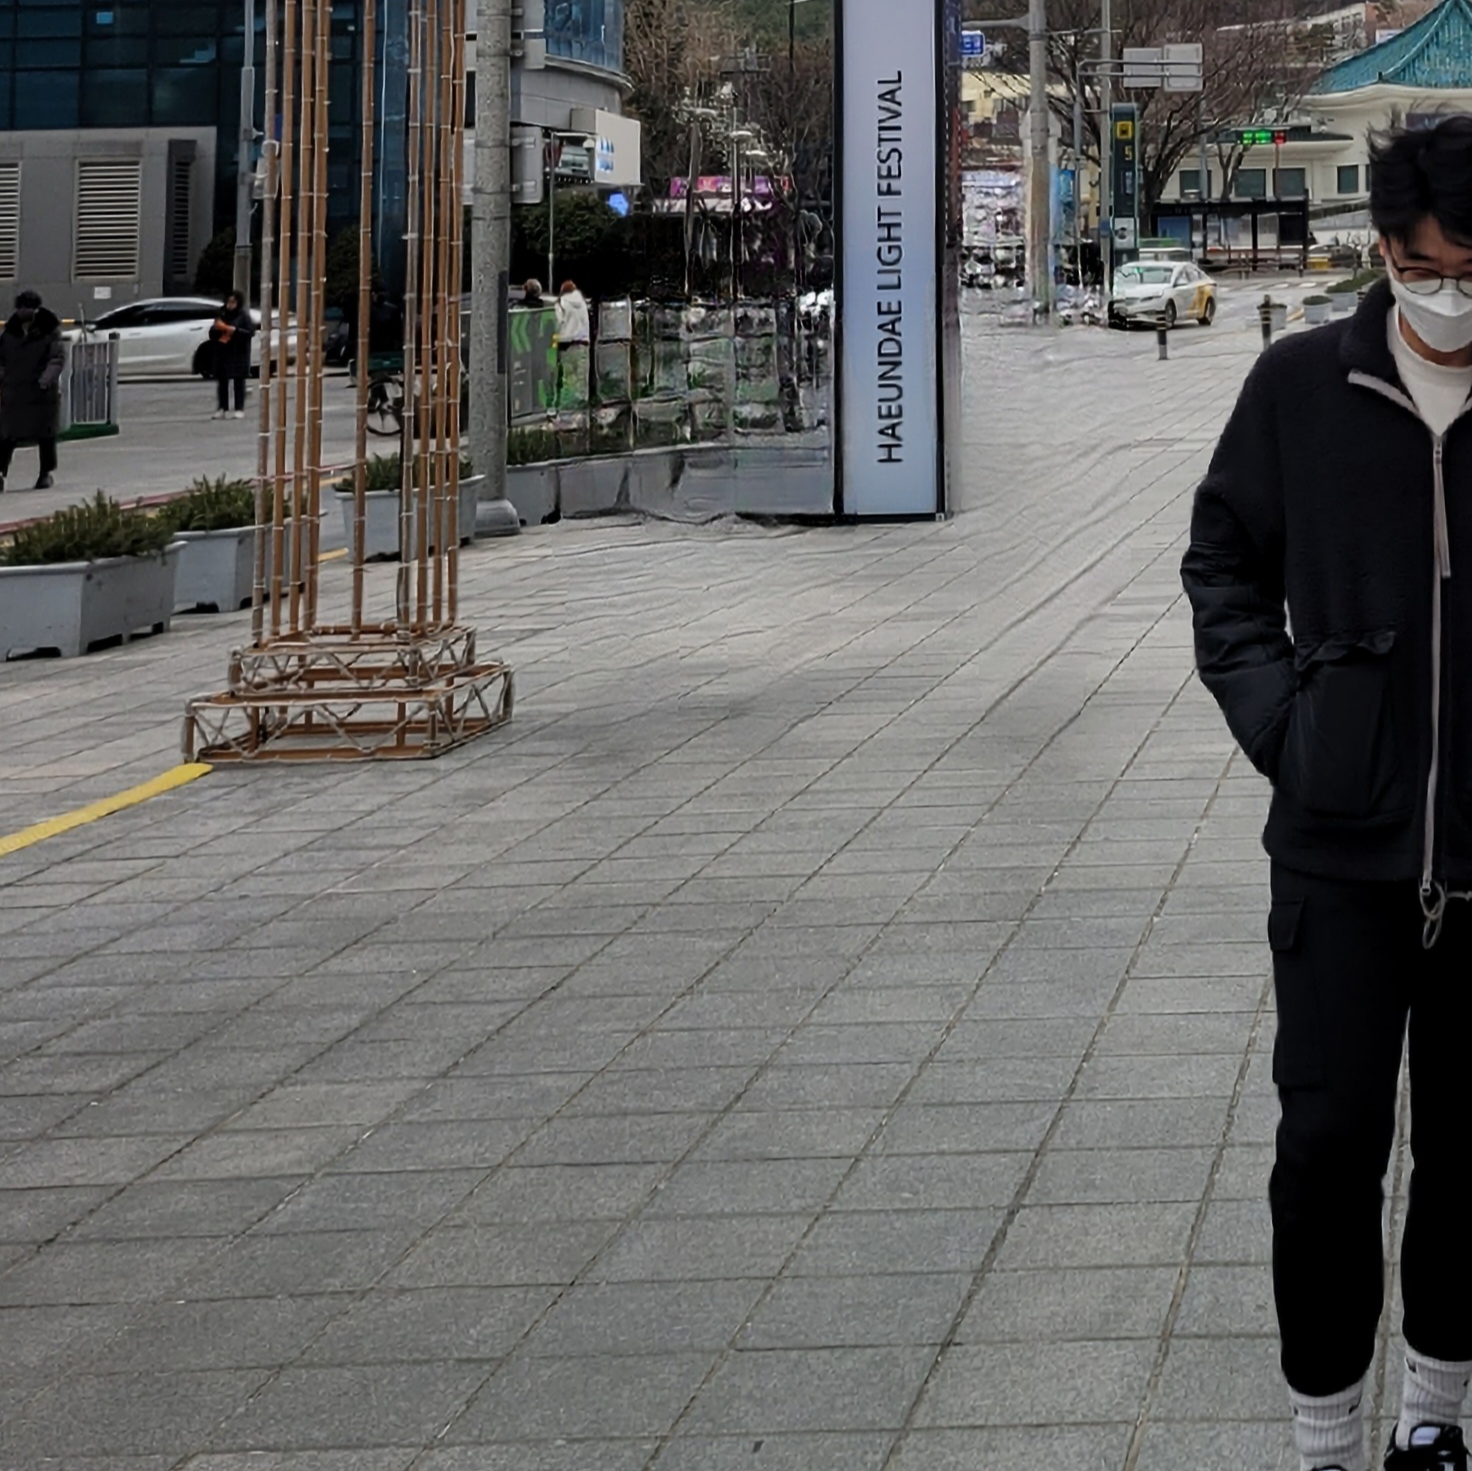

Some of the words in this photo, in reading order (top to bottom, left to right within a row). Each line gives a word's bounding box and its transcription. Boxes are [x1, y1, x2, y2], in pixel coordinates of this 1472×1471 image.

[877, 70, 902, 197] FESTIVAL
[877, 205, 903, 291] LIGHT
[877, 299, 904, 464] HAEUNDAE
